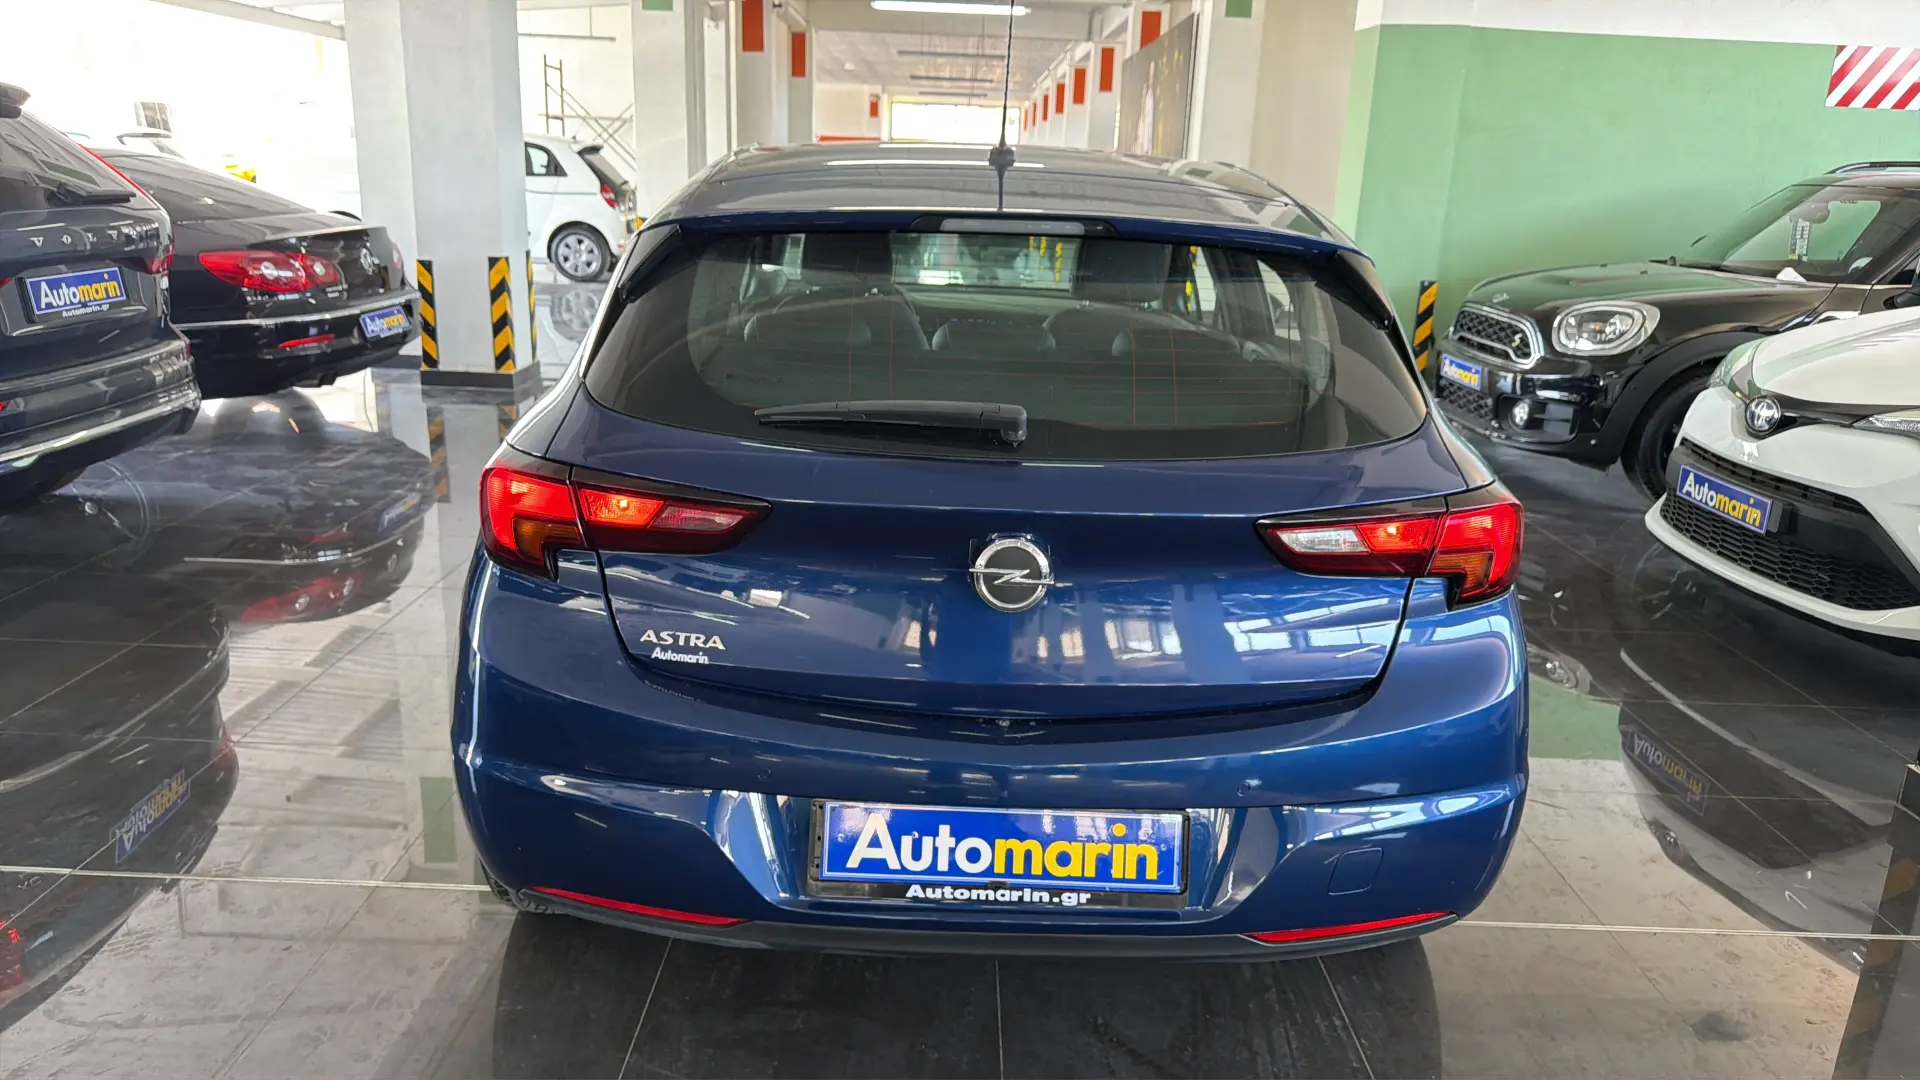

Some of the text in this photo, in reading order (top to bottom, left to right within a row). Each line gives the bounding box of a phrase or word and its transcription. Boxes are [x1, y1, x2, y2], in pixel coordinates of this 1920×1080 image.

[39, 273, 121, 308] Automarin
[61, 304, 110, 318] Automarin.gr
[1682, 472, 1762, 527] Automarin
[640, 629, 726, 650] ASTRA
[651, 647, 709, 665] Automarin
[845, 812, 1159, 880] Automarin
[905, 883, 1092, 906] Automarin.gr
